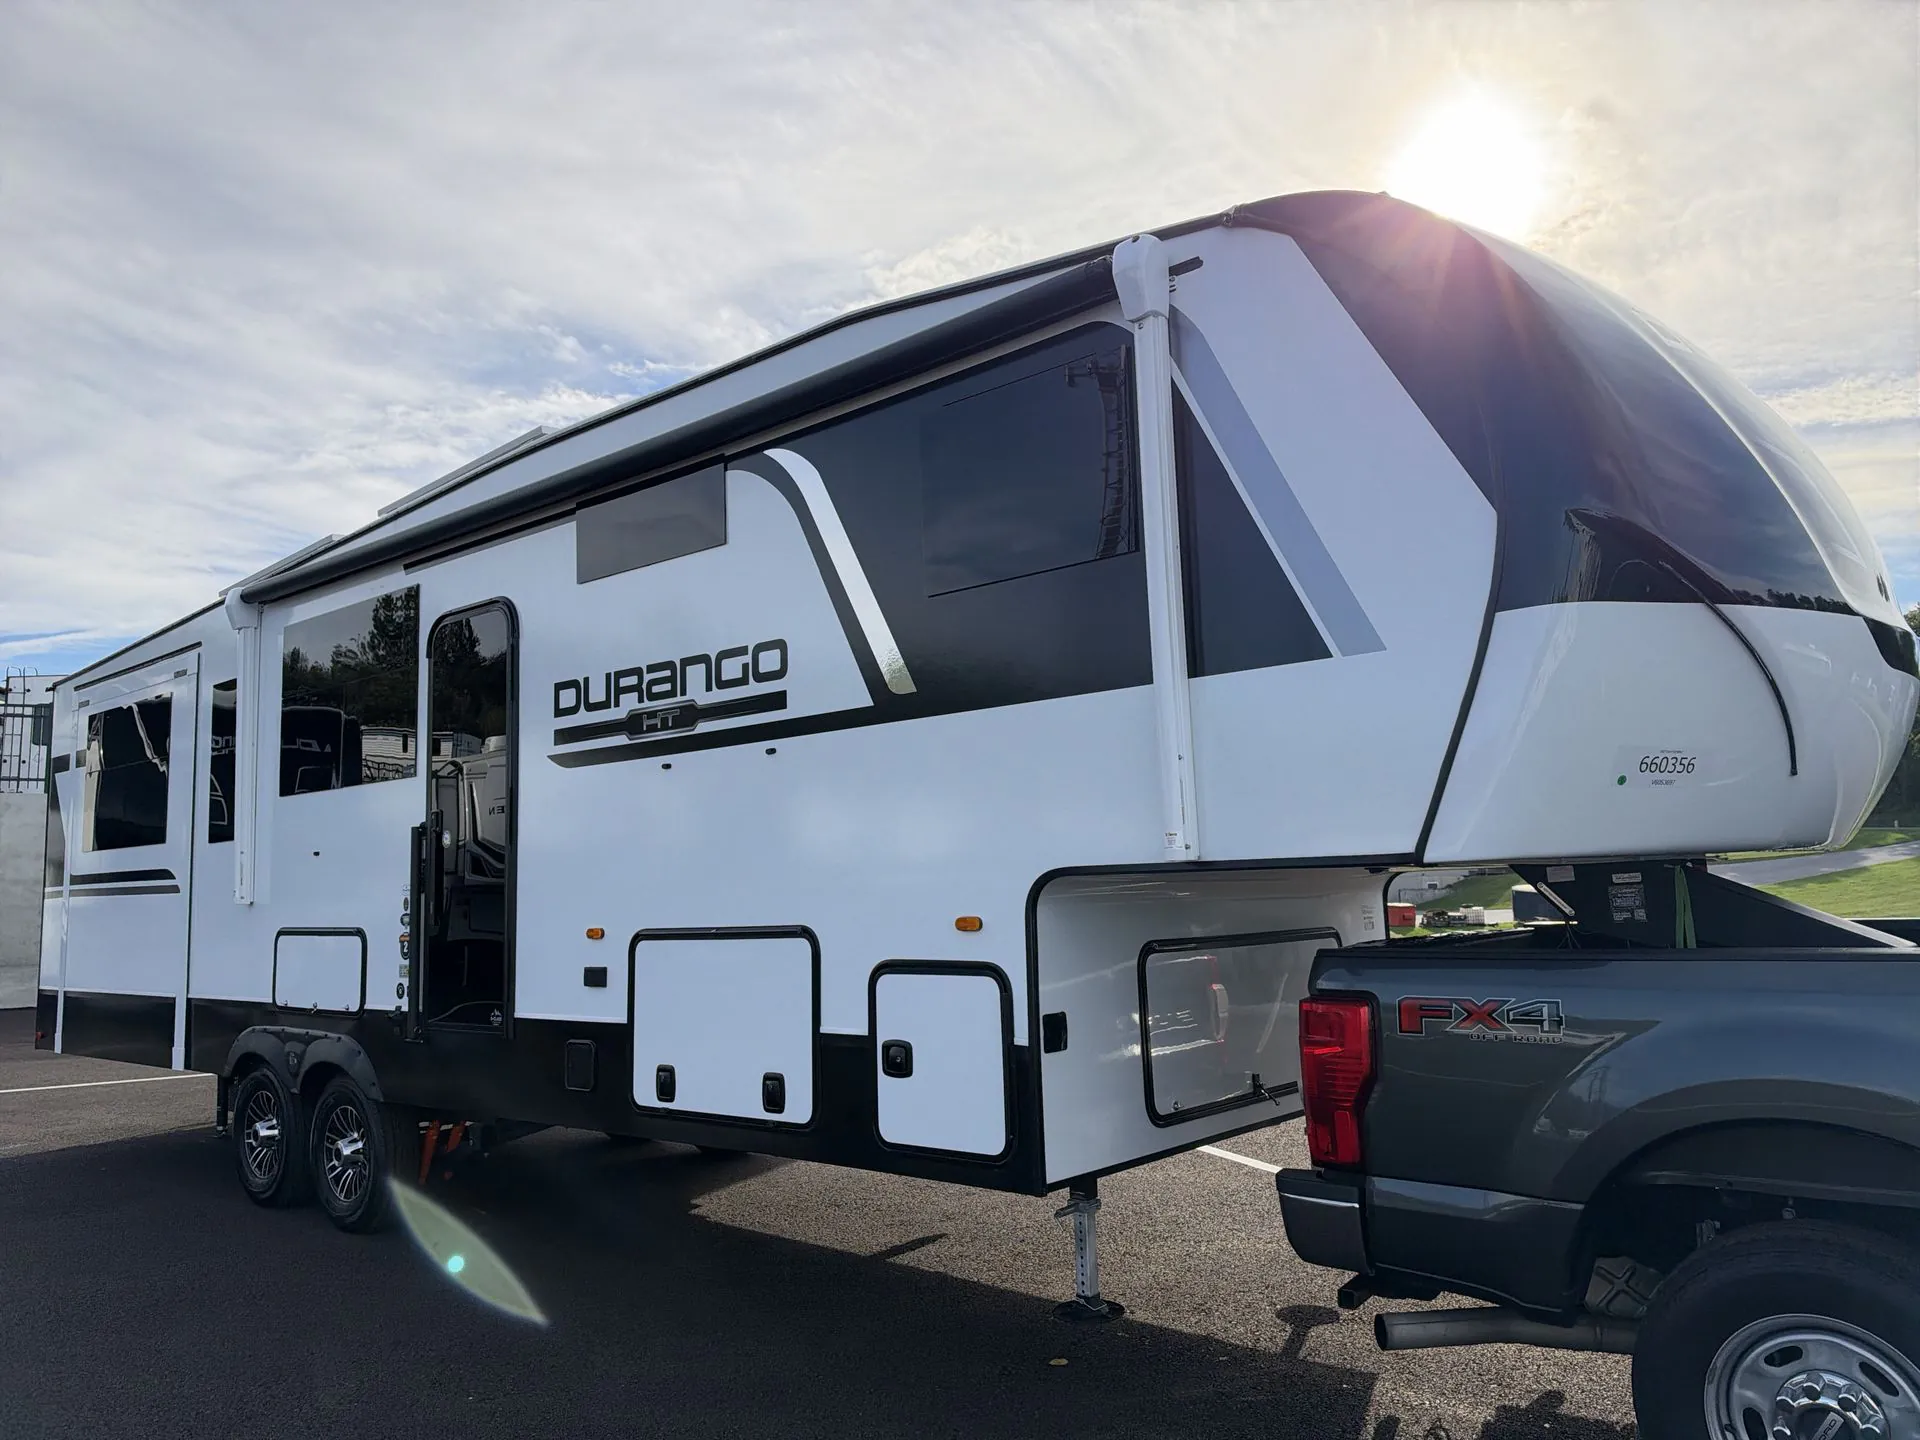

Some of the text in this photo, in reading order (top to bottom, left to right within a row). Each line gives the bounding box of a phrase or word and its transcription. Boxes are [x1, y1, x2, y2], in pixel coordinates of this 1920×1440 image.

[641, 708, 682, 731] HT
[1638, 755, 1697, 774] 660356
[1396, 995, 1565, 1036] FX4
[1468, 1032, 1564, 1045] OFF ROAD
